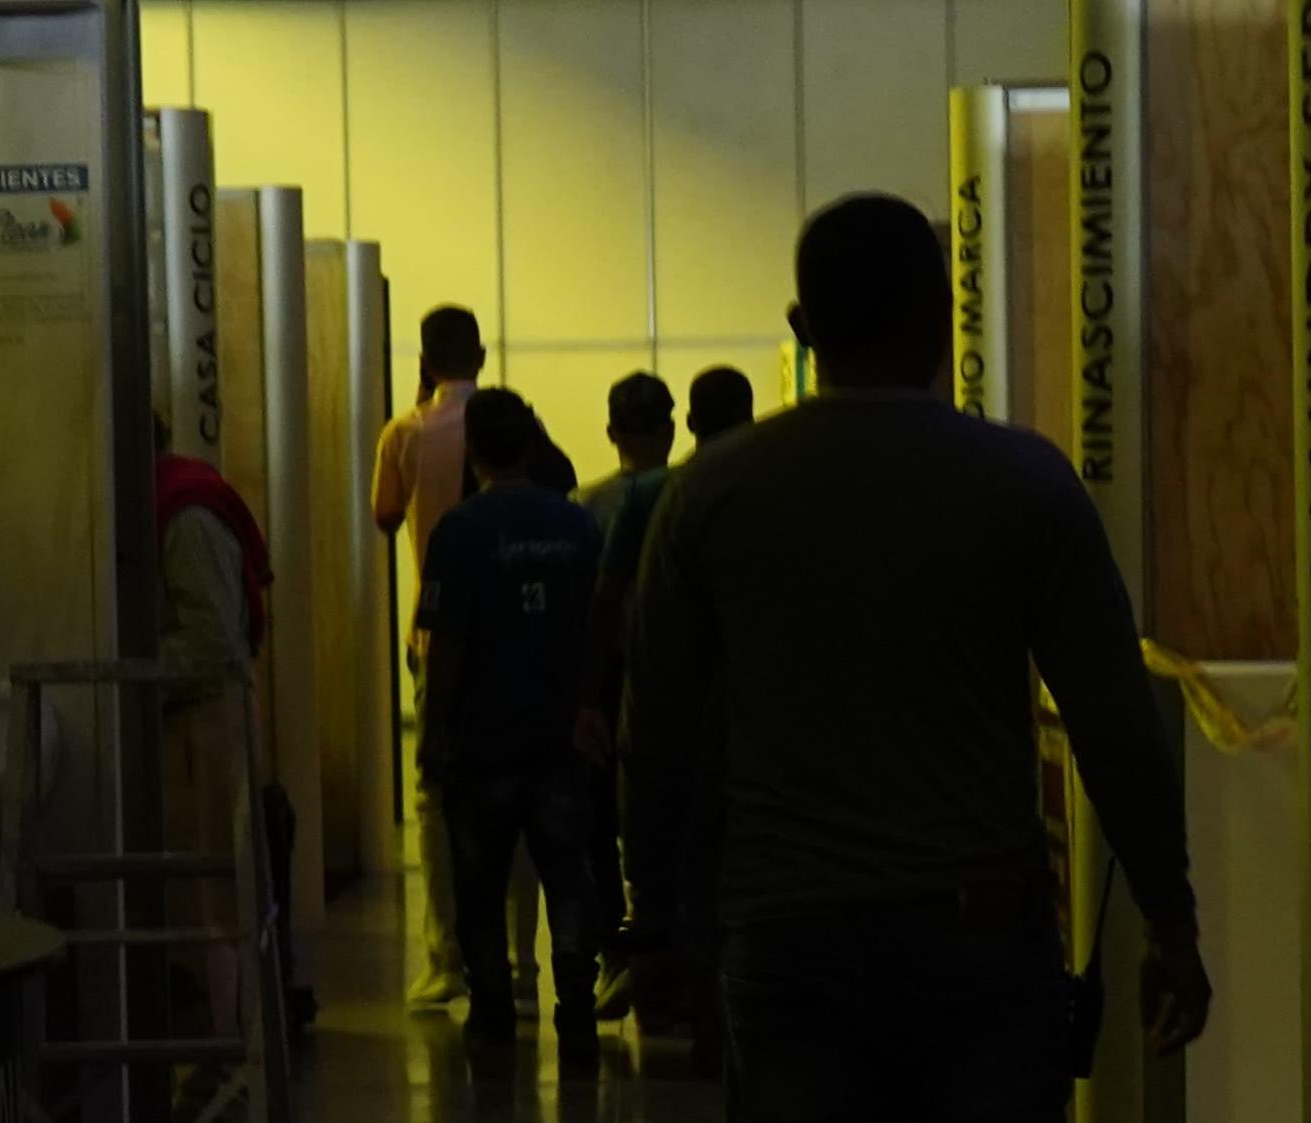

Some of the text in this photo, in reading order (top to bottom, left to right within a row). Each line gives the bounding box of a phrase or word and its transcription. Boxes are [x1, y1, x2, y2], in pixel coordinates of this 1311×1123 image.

[958, 174, 983, 337] MARCA
[1080, 50, 1114, 483] RINASCIMIENTO
[196, 331, 220, 447] CASA
